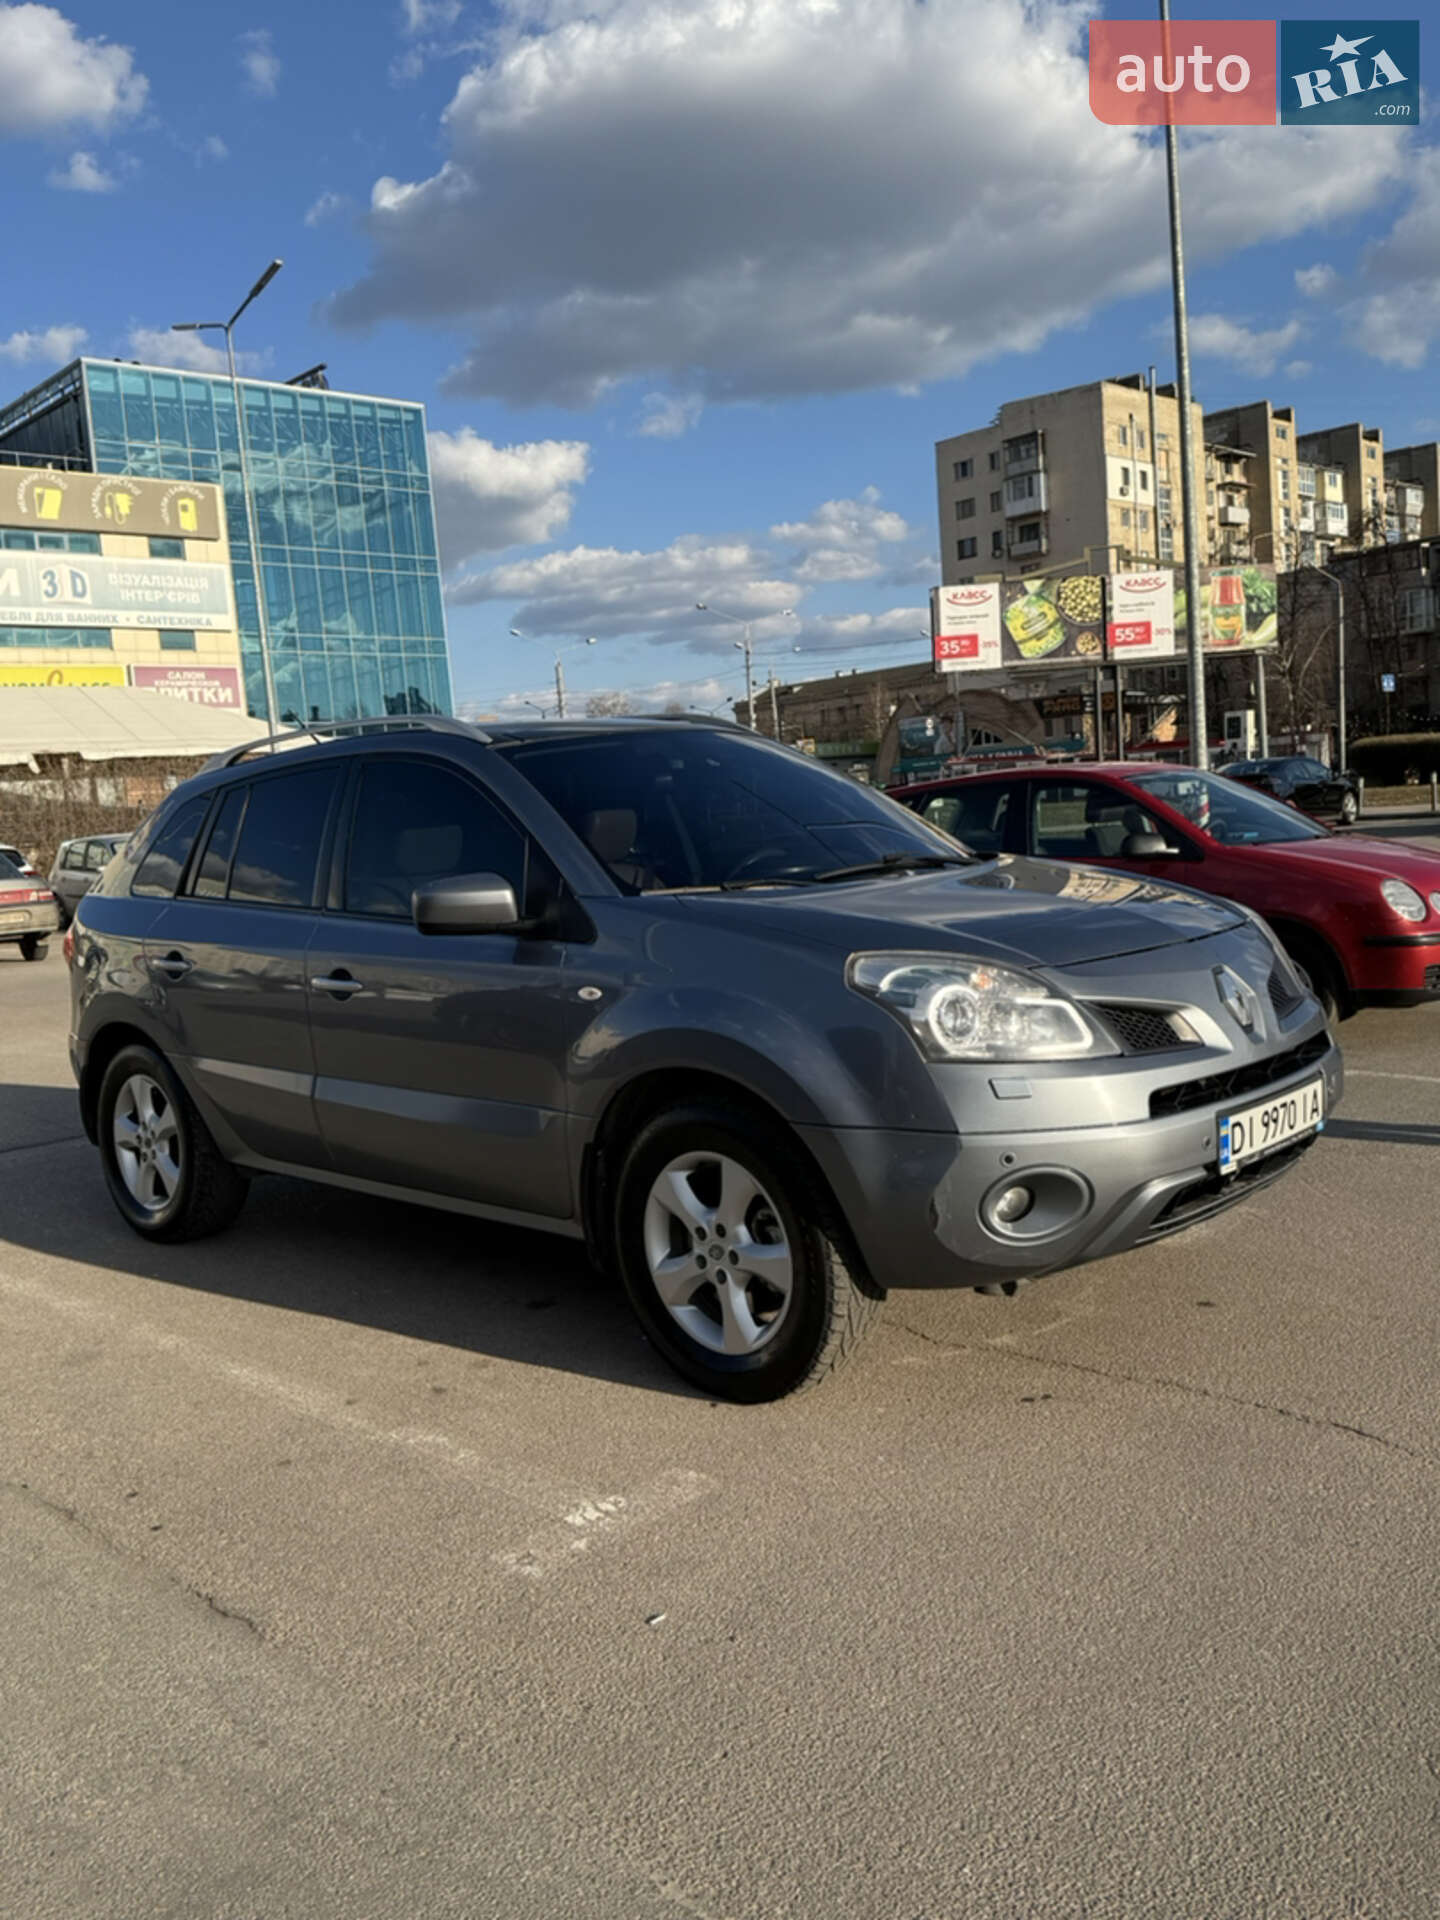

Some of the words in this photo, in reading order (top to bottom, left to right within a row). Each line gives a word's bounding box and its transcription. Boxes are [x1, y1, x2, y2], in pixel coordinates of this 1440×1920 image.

[43, 569, 87, 598] 3D
[1115, 627, 1135, 642] 55
[940, 640, 960, 656] 35
[1261, 1100, 1297, 1143] 9970
